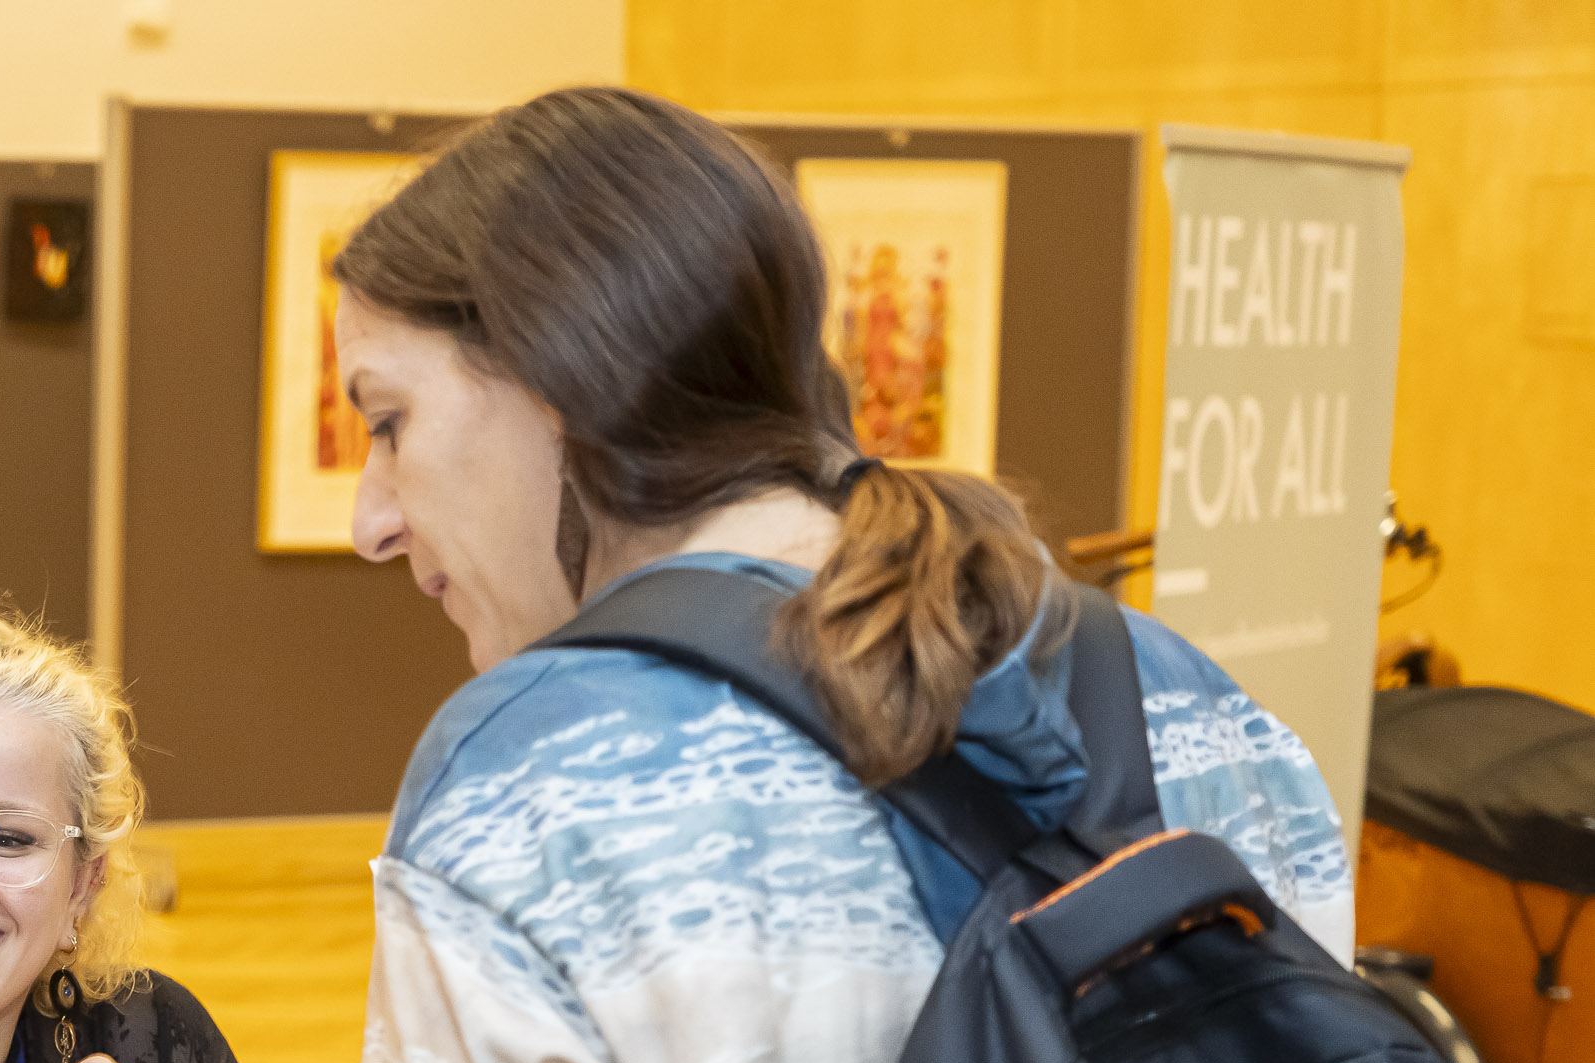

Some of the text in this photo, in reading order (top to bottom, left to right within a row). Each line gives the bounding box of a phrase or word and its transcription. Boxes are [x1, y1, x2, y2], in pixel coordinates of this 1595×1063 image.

[1172, 214, 1356, 348] HEALTH
[1159, 393, 1350, 530] FOR ALL
